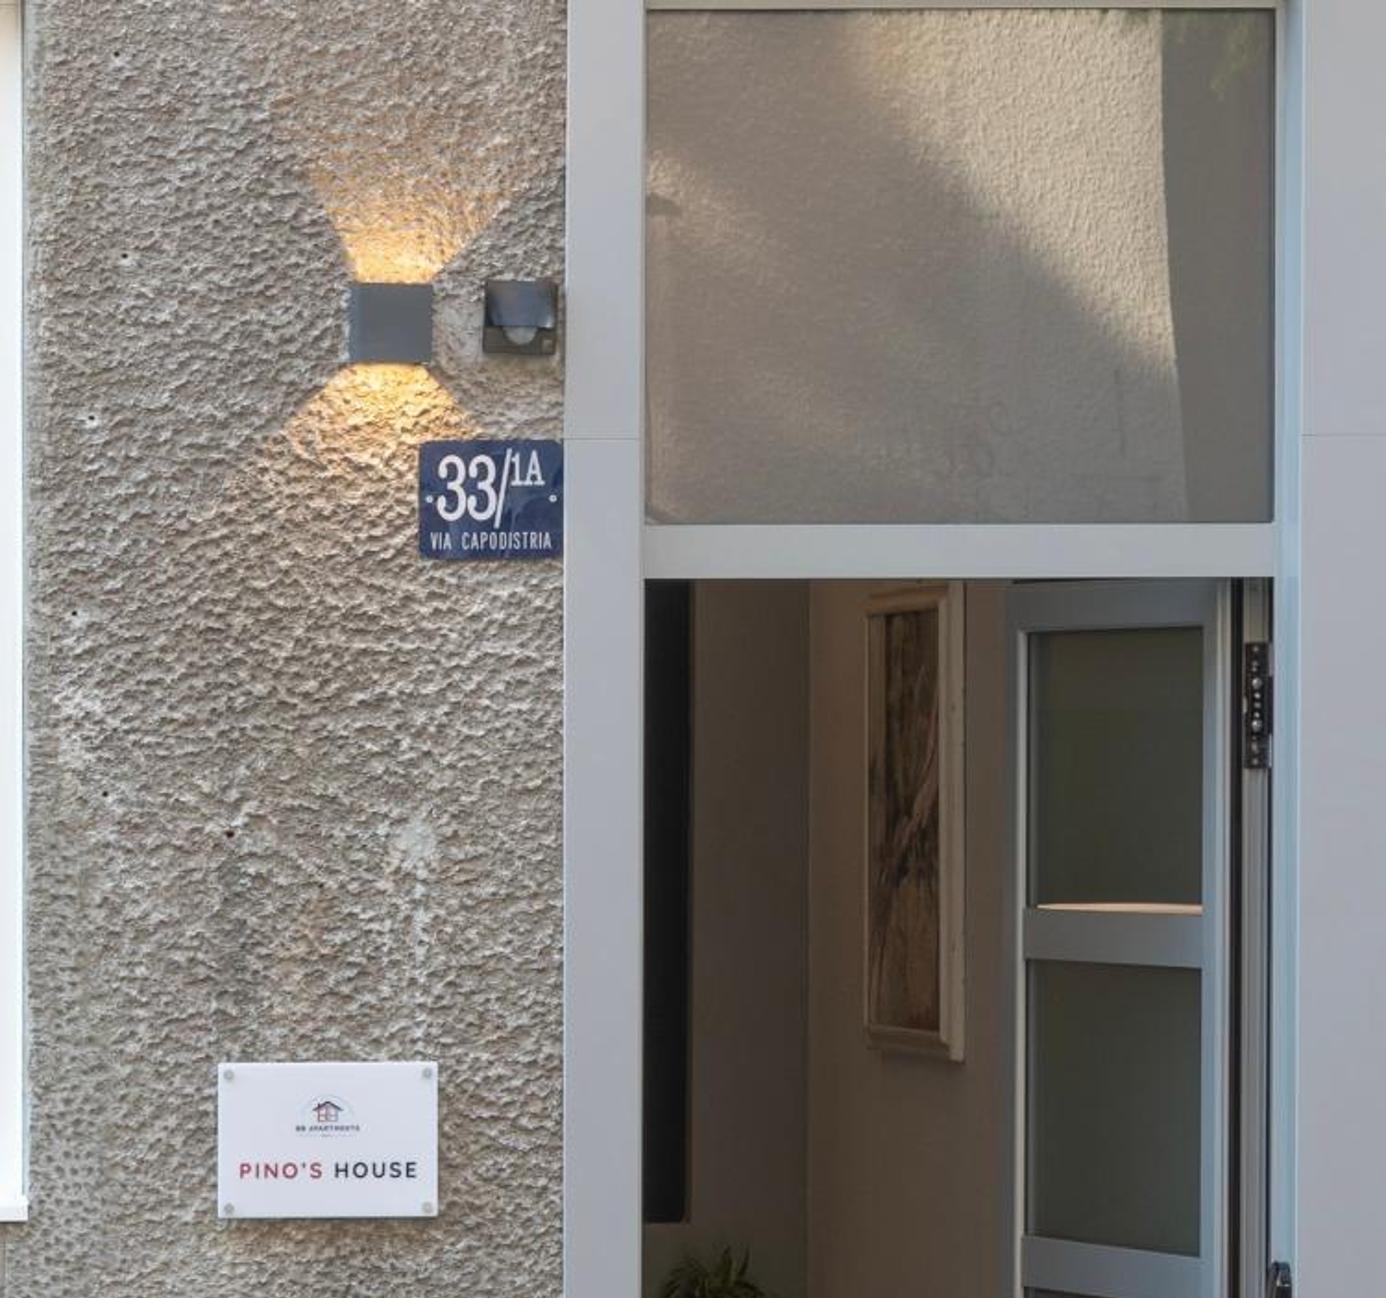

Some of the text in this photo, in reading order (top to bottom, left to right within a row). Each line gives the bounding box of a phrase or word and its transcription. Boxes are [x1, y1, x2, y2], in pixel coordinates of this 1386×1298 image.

[430, 531, 552, 550] VIA CAPODISTRIA
[239, 1161, 418, 1180] PINO'S HOUSE
